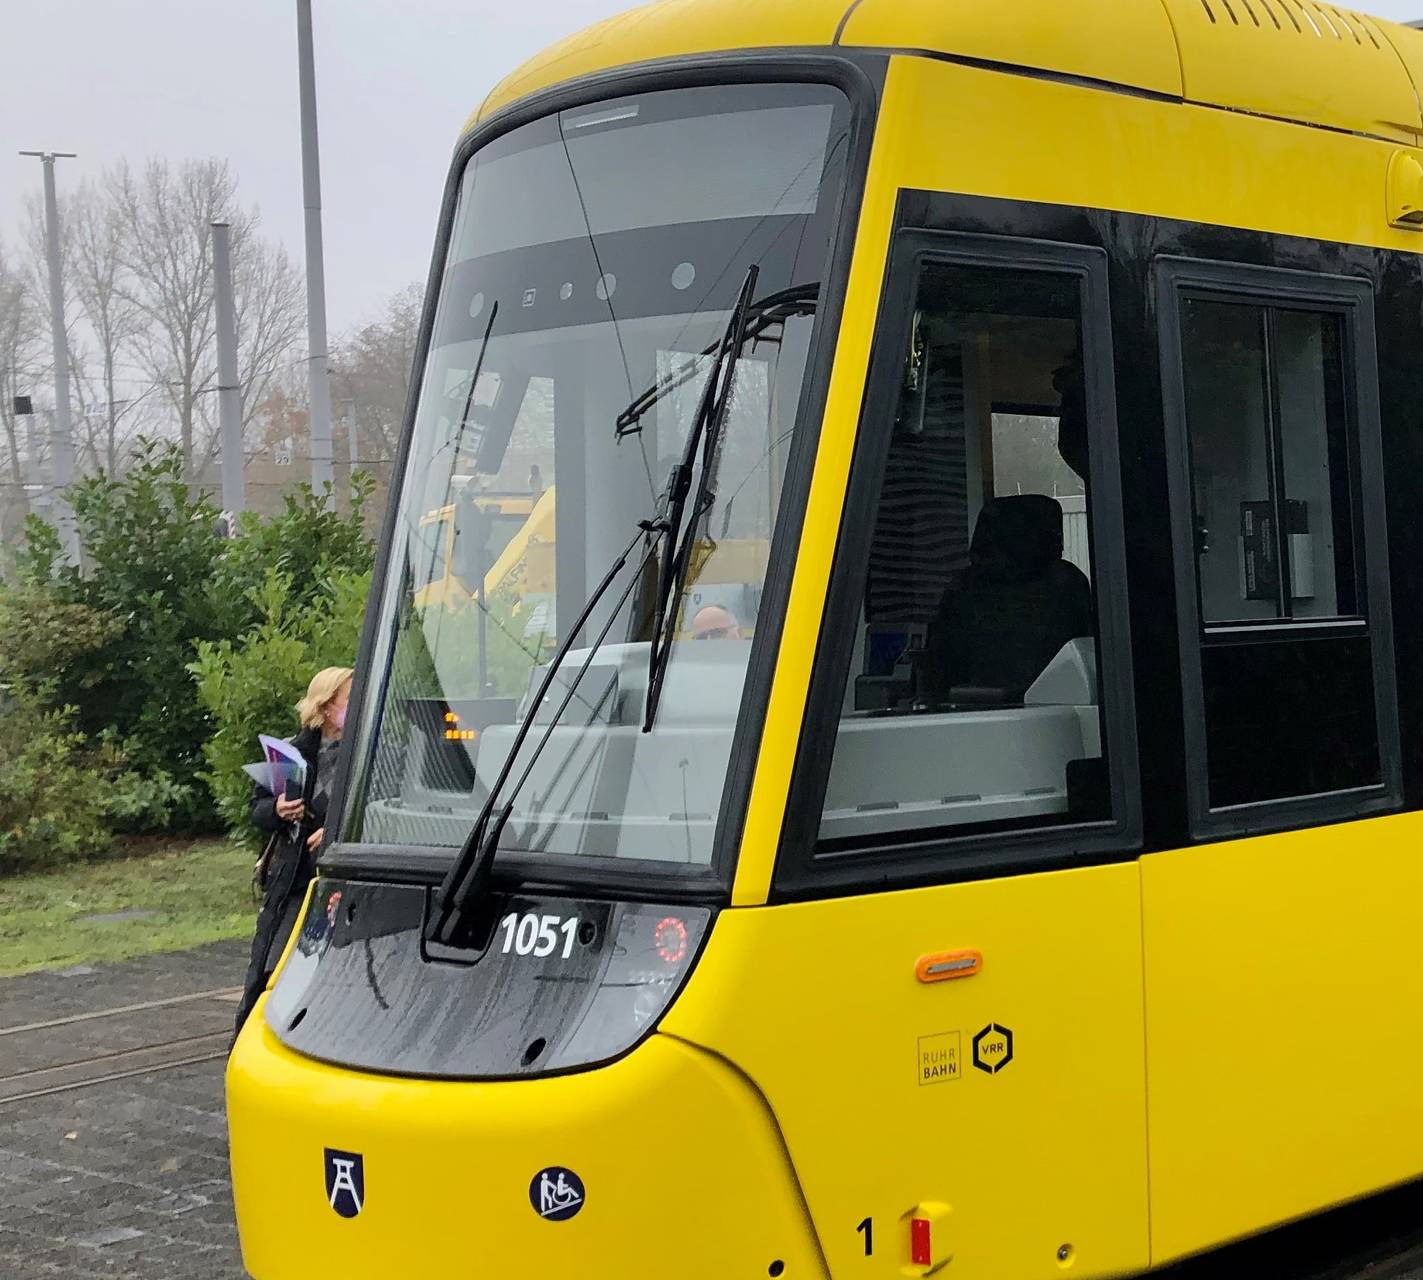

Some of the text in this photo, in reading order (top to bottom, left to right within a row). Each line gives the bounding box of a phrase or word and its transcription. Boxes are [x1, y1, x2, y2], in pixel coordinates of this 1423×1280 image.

[501, 912, 578, 959] 1051
[923, 1047, 956, 1065] RUHR
[982, 1041, 1004, 1056] VRR
[923, 1062, 957, 1080] BAHN
[856, 1216, 873, 1256] 1
